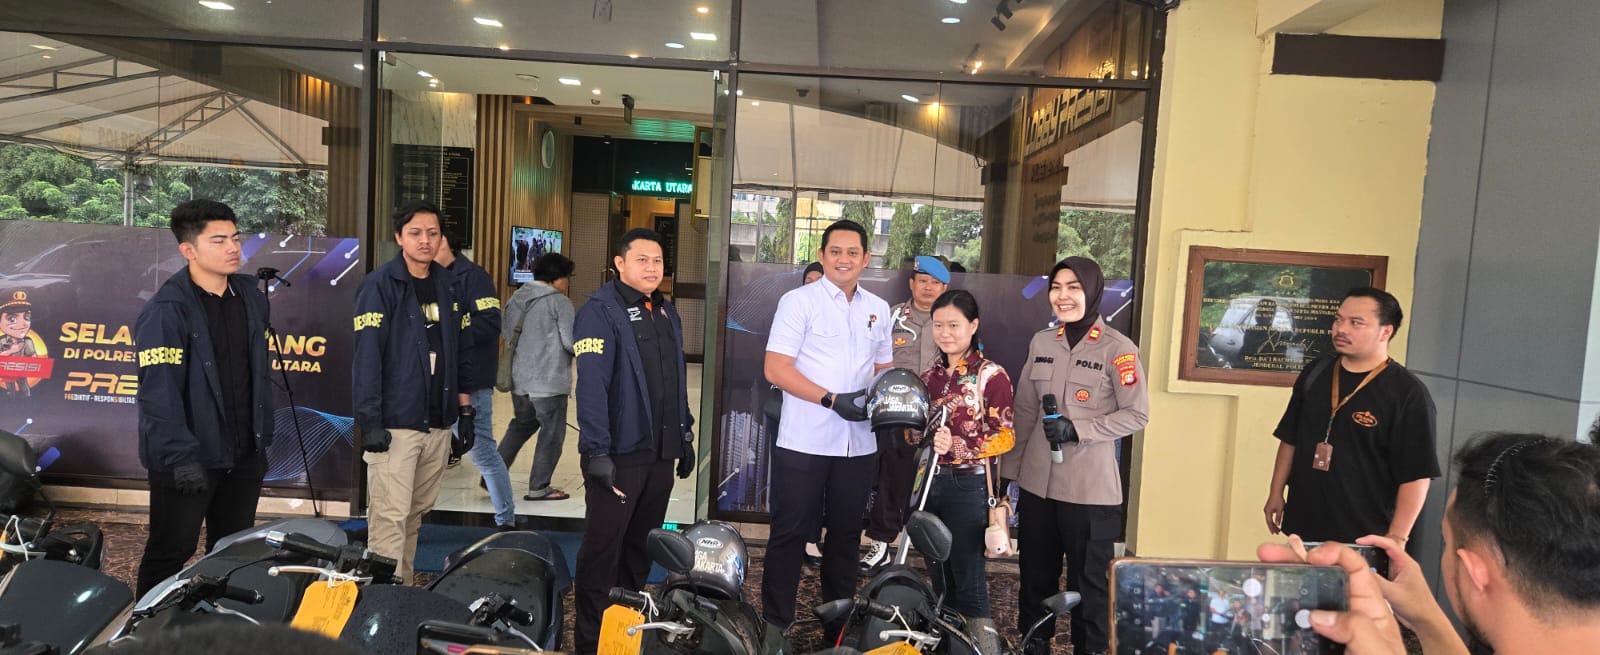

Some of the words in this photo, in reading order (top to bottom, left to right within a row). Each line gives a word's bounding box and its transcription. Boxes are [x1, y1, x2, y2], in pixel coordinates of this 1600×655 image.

[631, 180, 662, 192] KARTA
[665, 182, 693, 194] UTARA
[59, 321, 136, 346] SELA
[265, 329, 327, 357] ANG
[63, 347, 80, 359] DI
[271, 359, 322, 373] UTARA
[1076, 359, 1103, 371] POLRI
[693, 559, 724, 574] AKARTA
